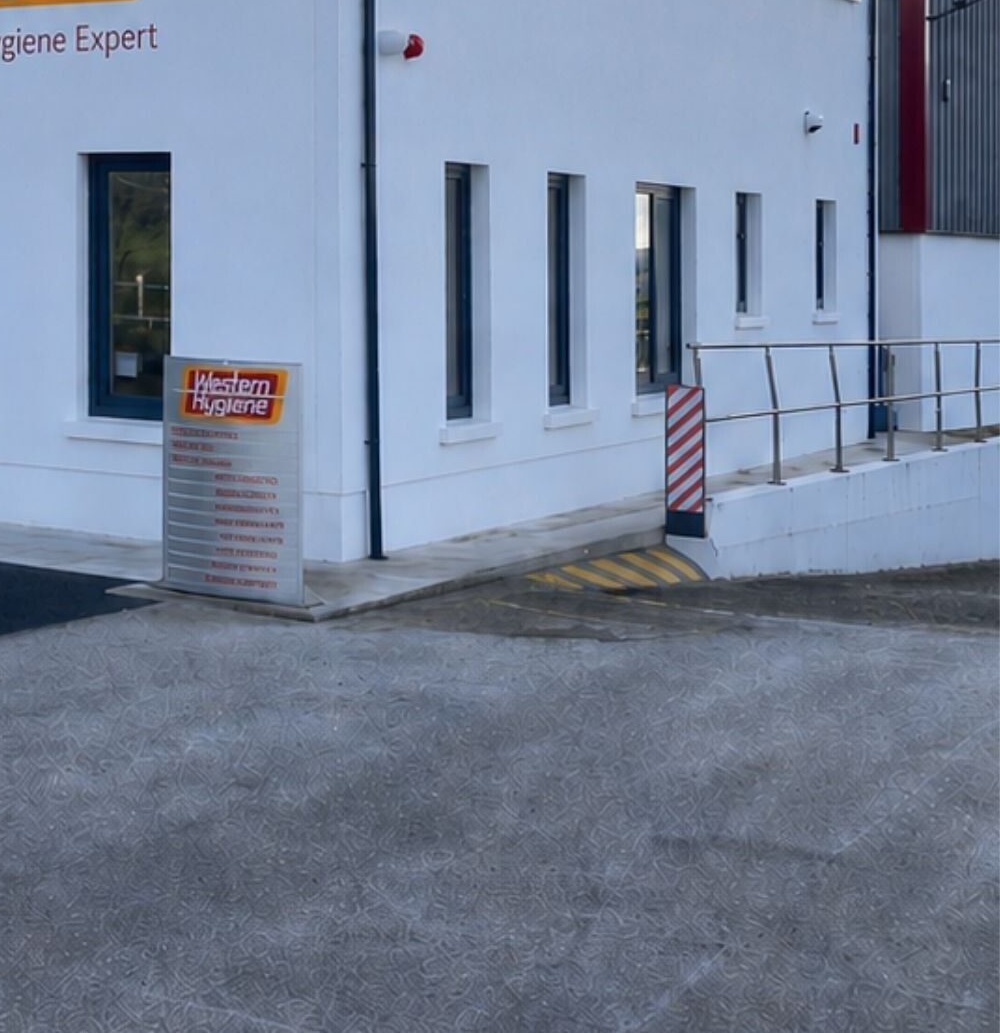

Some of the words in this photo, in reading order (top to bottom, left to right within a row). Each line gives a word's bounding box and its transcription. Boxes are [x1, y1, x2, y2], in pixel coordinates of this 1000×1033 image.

[75, 23, 158, 58] Expert
[194, 370, 270, 396] Western
[192, 392, 268, 417] Hygiene
